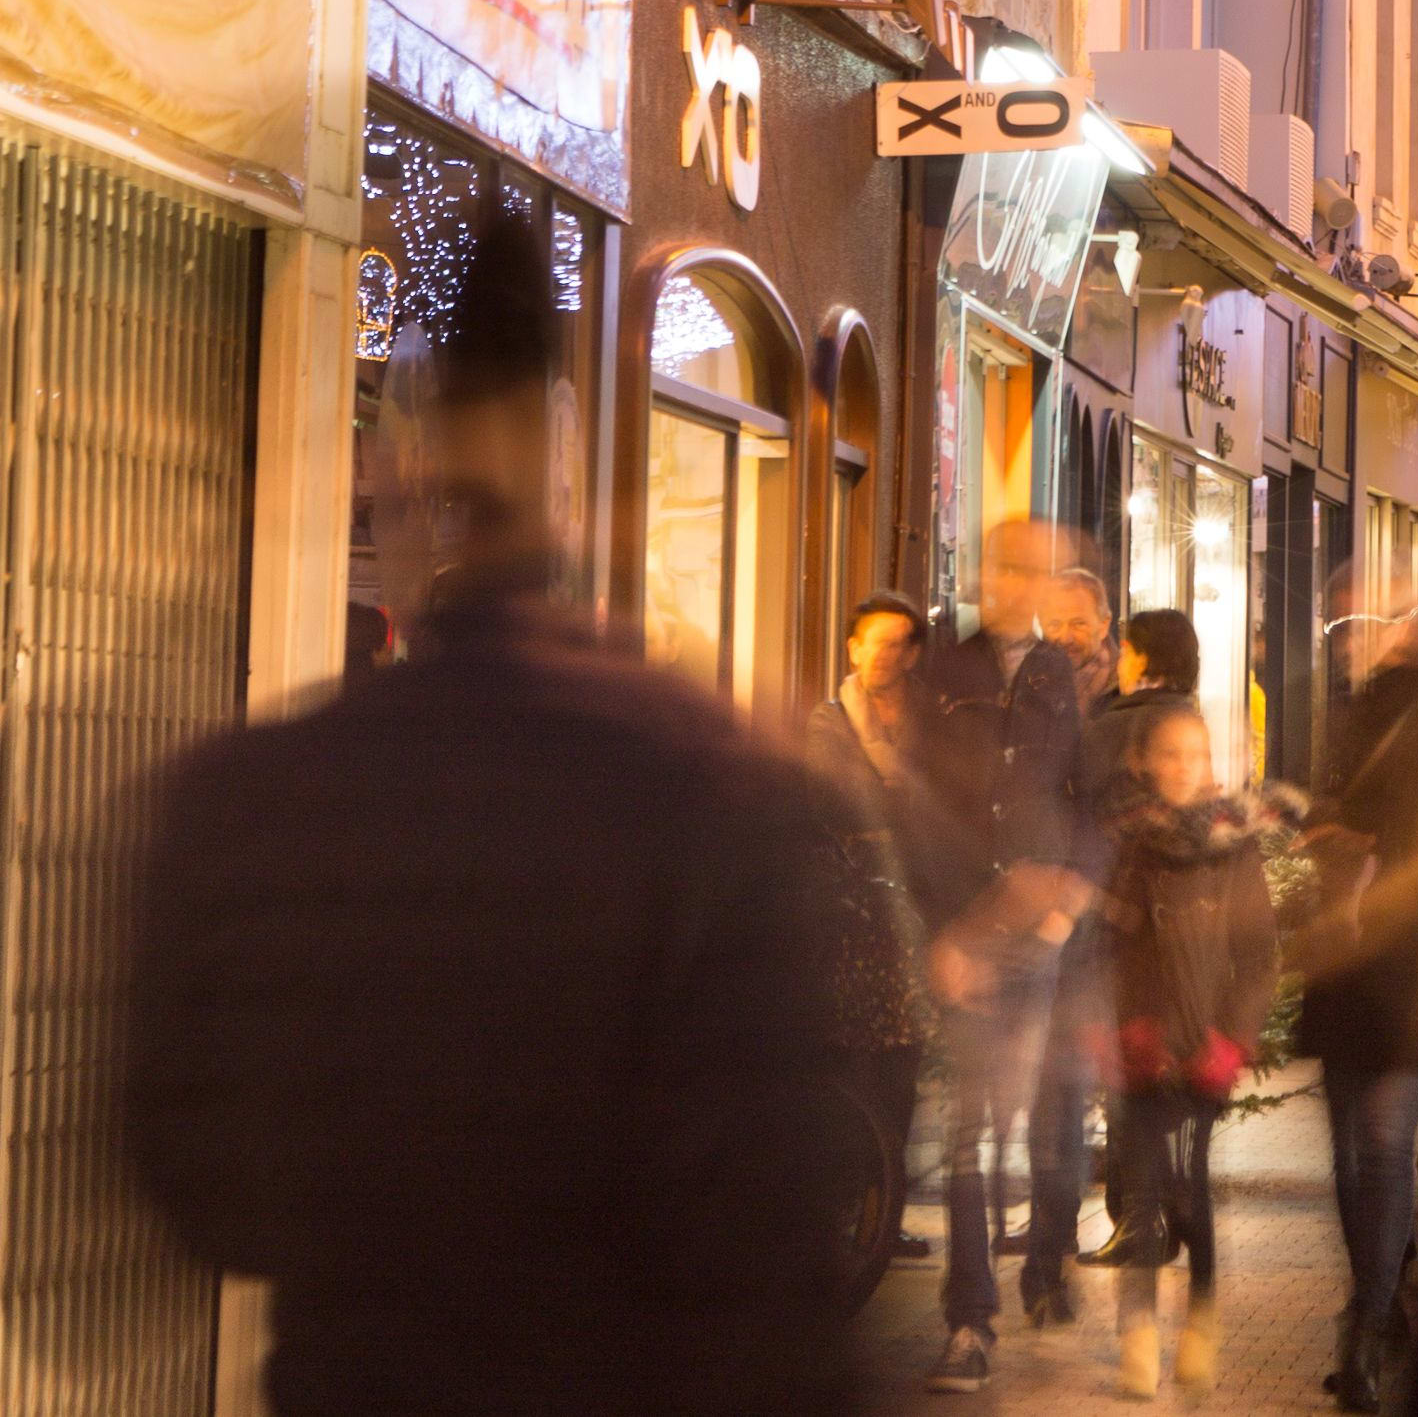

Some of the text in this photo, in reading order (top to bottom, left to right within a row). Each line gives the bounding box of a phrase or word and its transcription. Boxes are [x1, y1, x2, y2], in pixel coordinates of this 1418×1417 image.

[681, 5, 761, 213] XO
[897, 90, 1070, 142] X AND O
